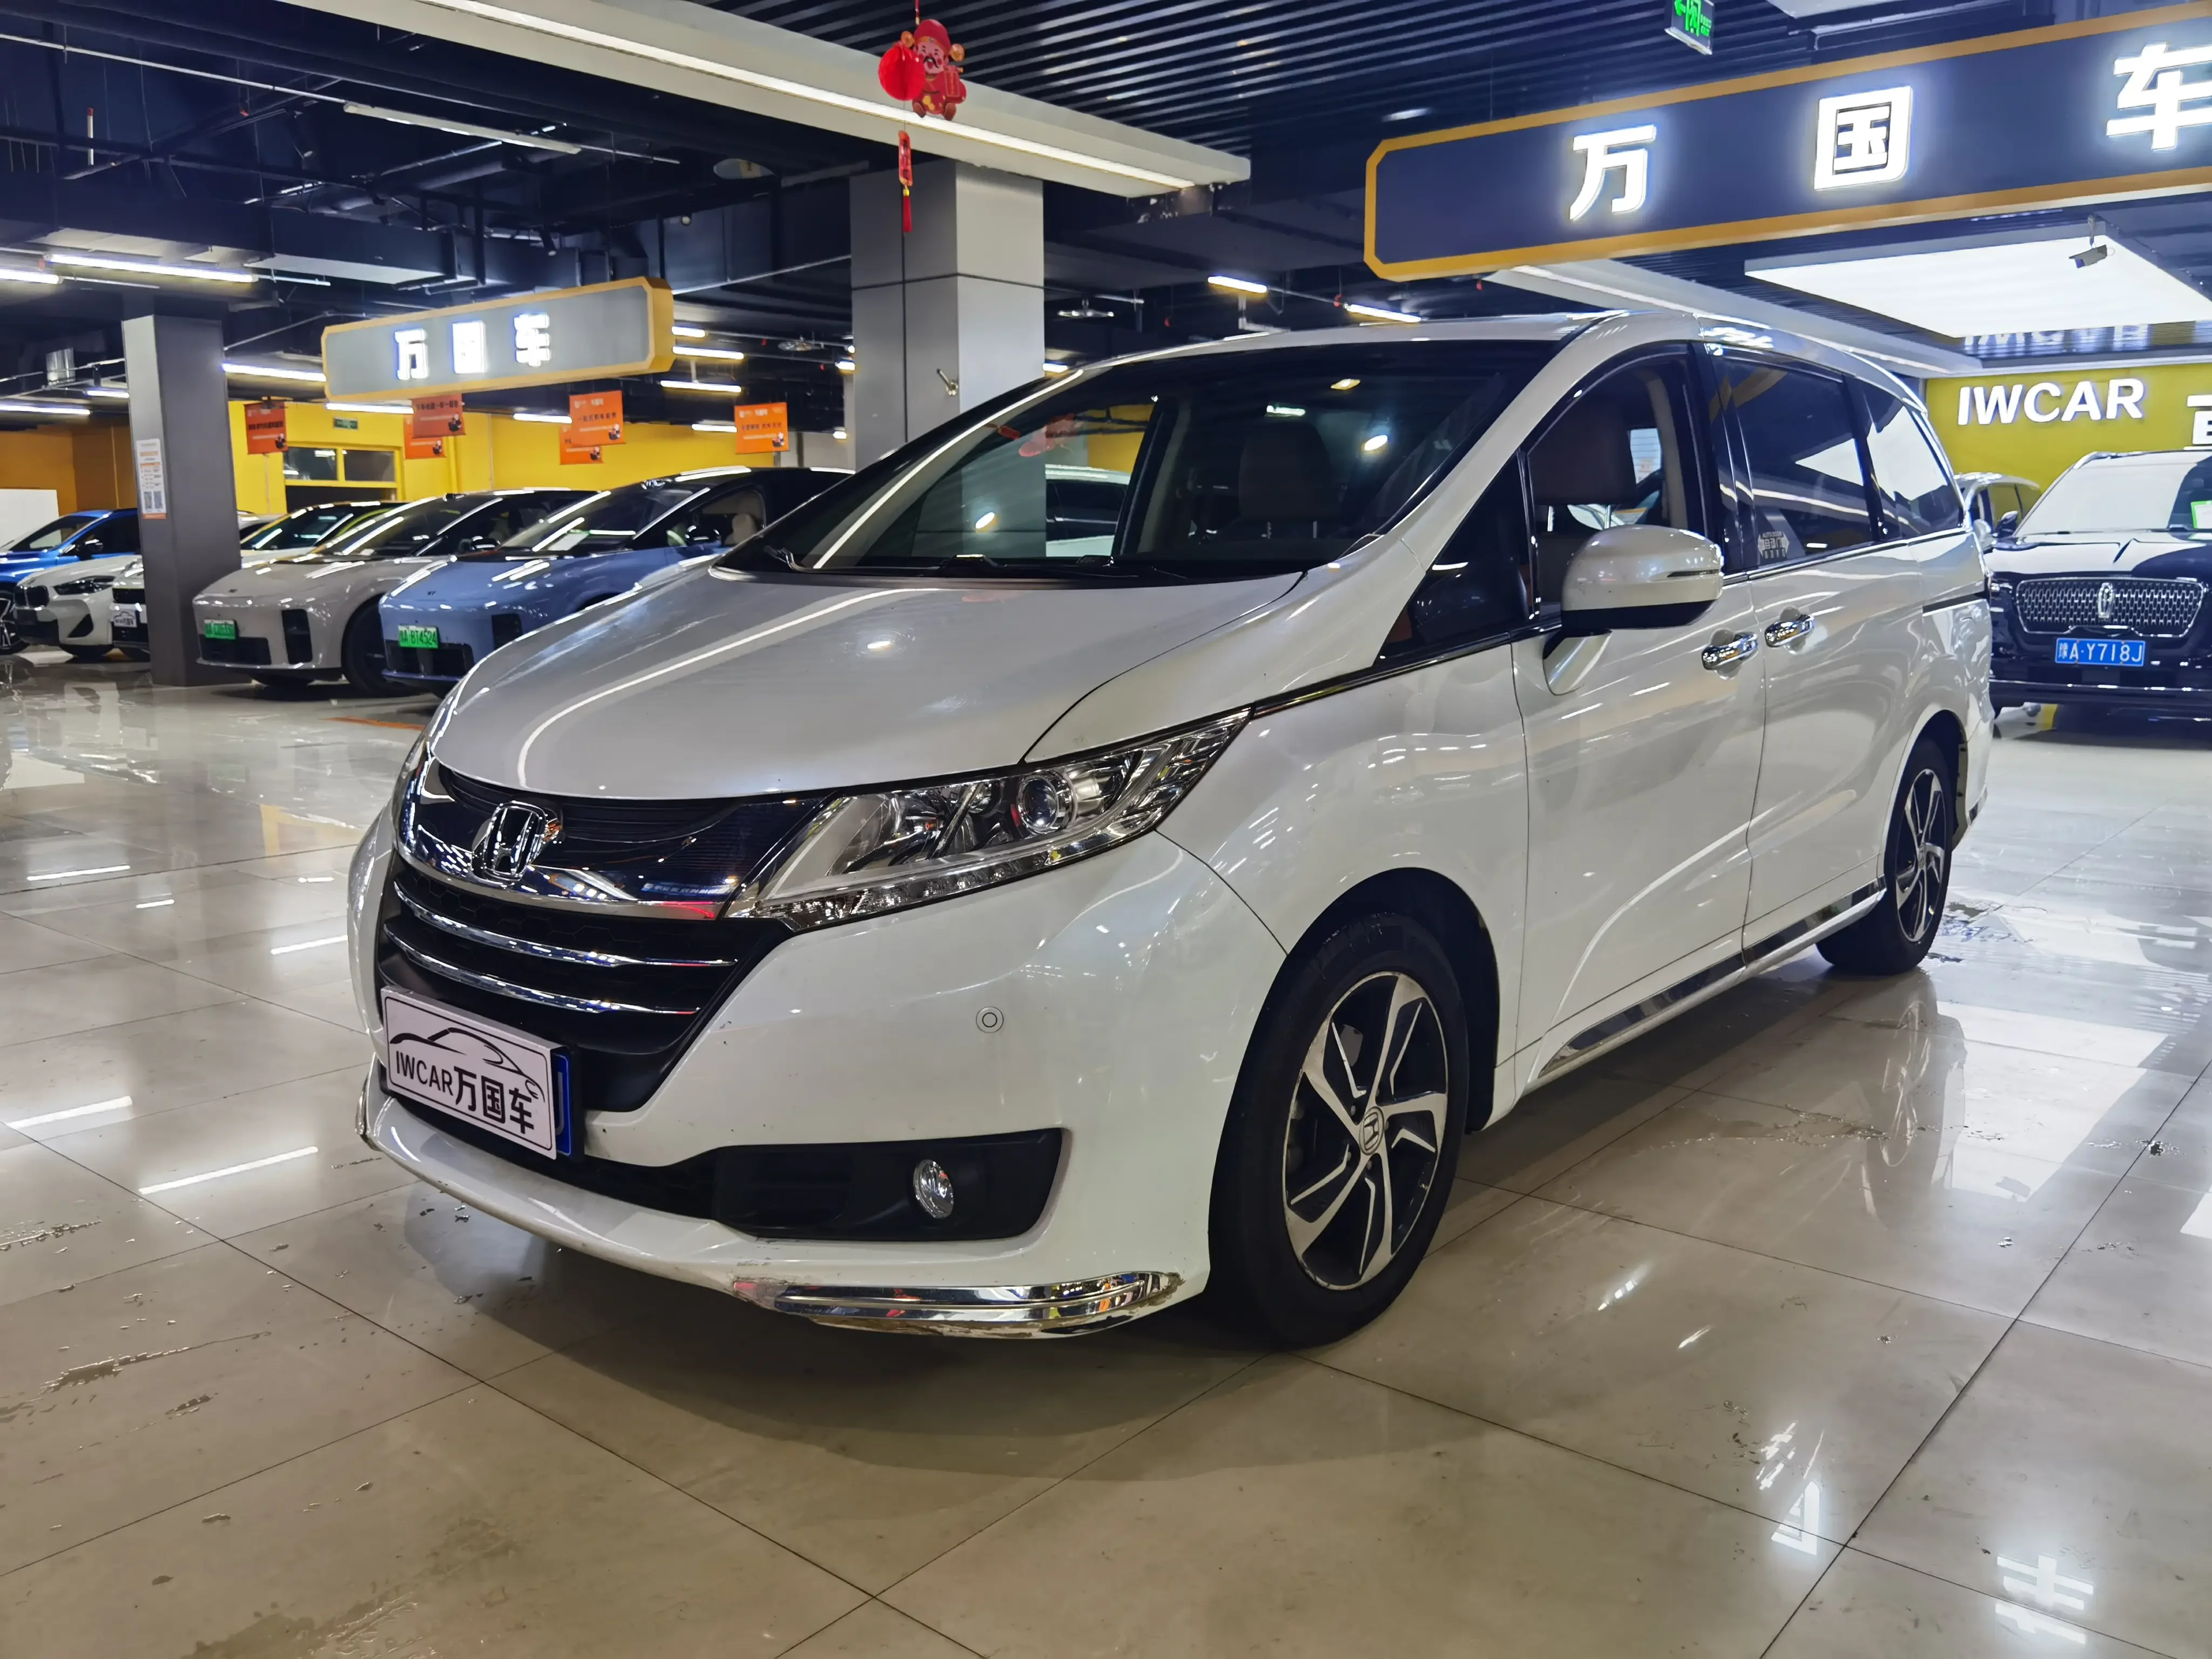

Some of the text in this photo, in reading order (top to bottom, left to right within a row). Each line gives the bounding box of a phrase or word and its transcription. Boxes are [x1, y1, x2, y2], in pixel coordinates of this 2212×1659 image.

[1569, 42, 2212, 221] 万国车
[1958, 377, 2145, 426] IWCAR
